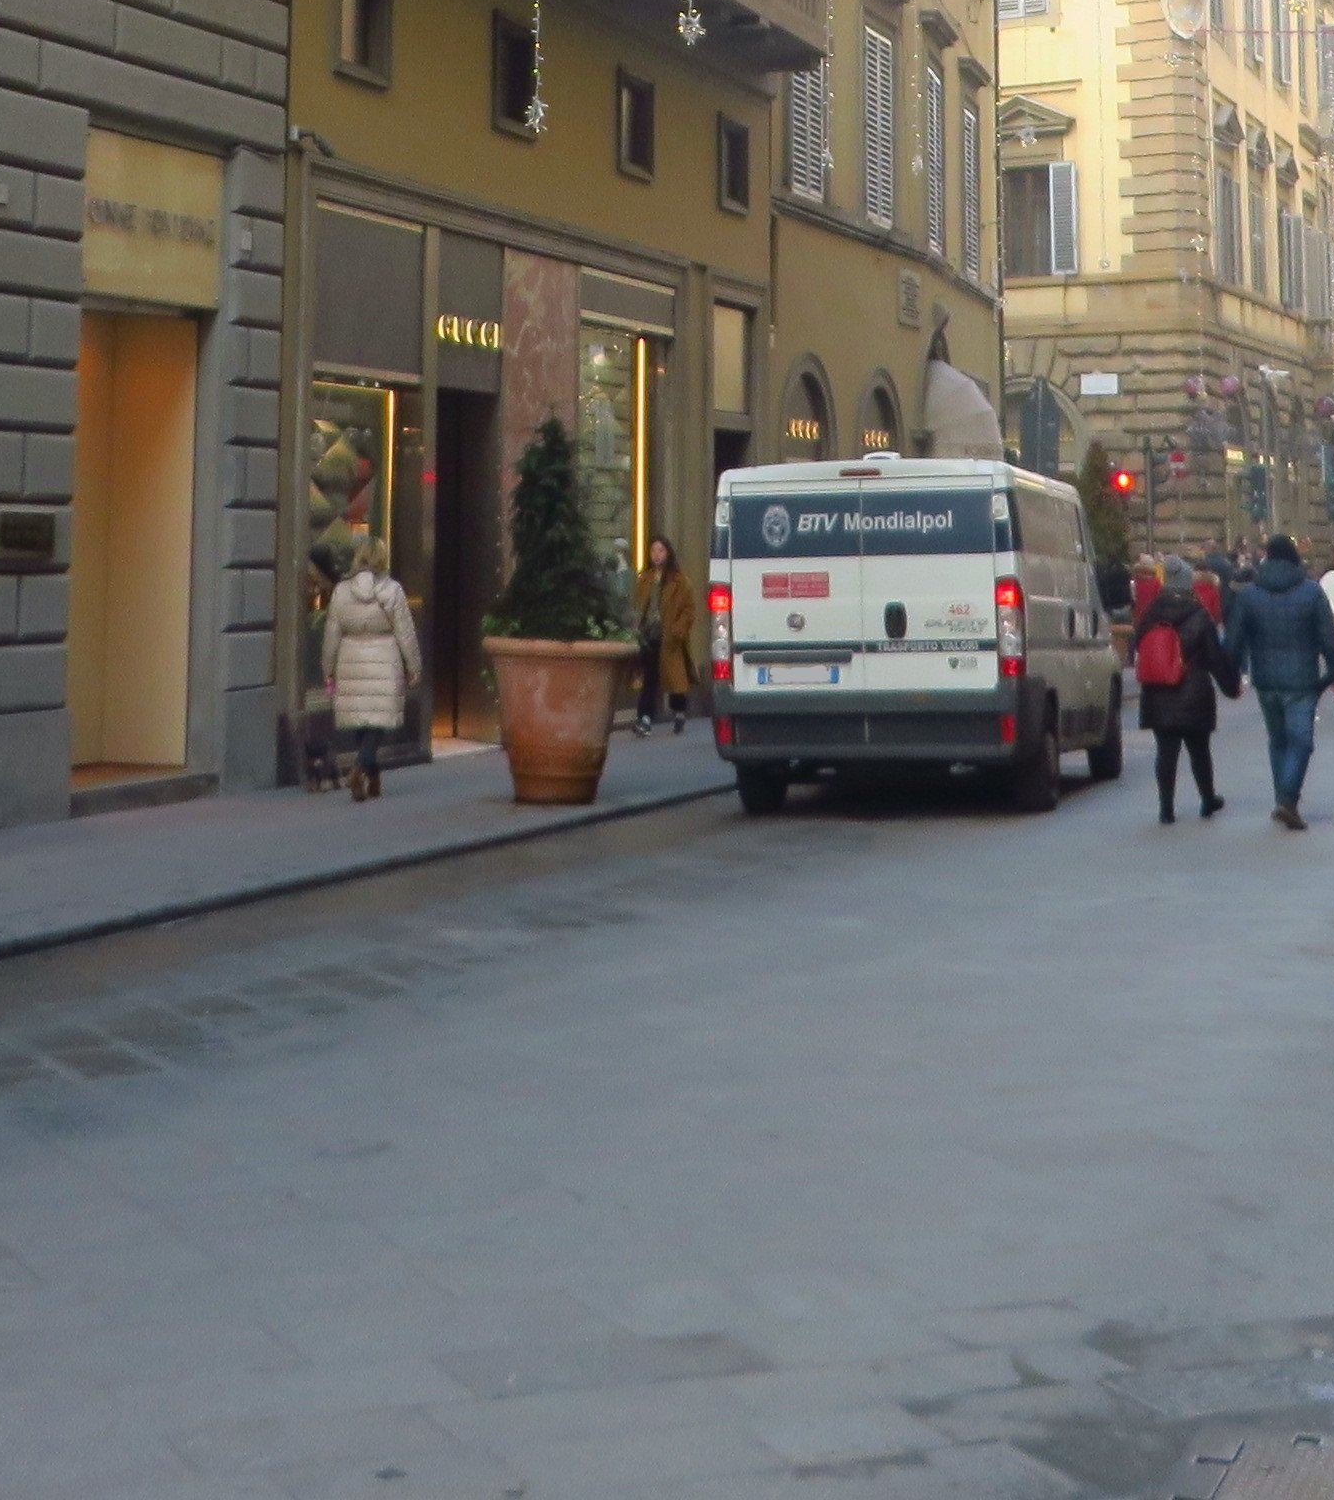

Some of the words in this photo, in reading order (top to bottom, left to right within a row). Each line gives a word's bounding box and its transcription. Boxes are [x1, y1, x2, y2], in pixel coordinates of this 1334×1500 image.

[436, 314, 502, 349] GUCCI
[797, 512, 838, 532] BTV
[844, 510, 953, 534] Mondialpol
